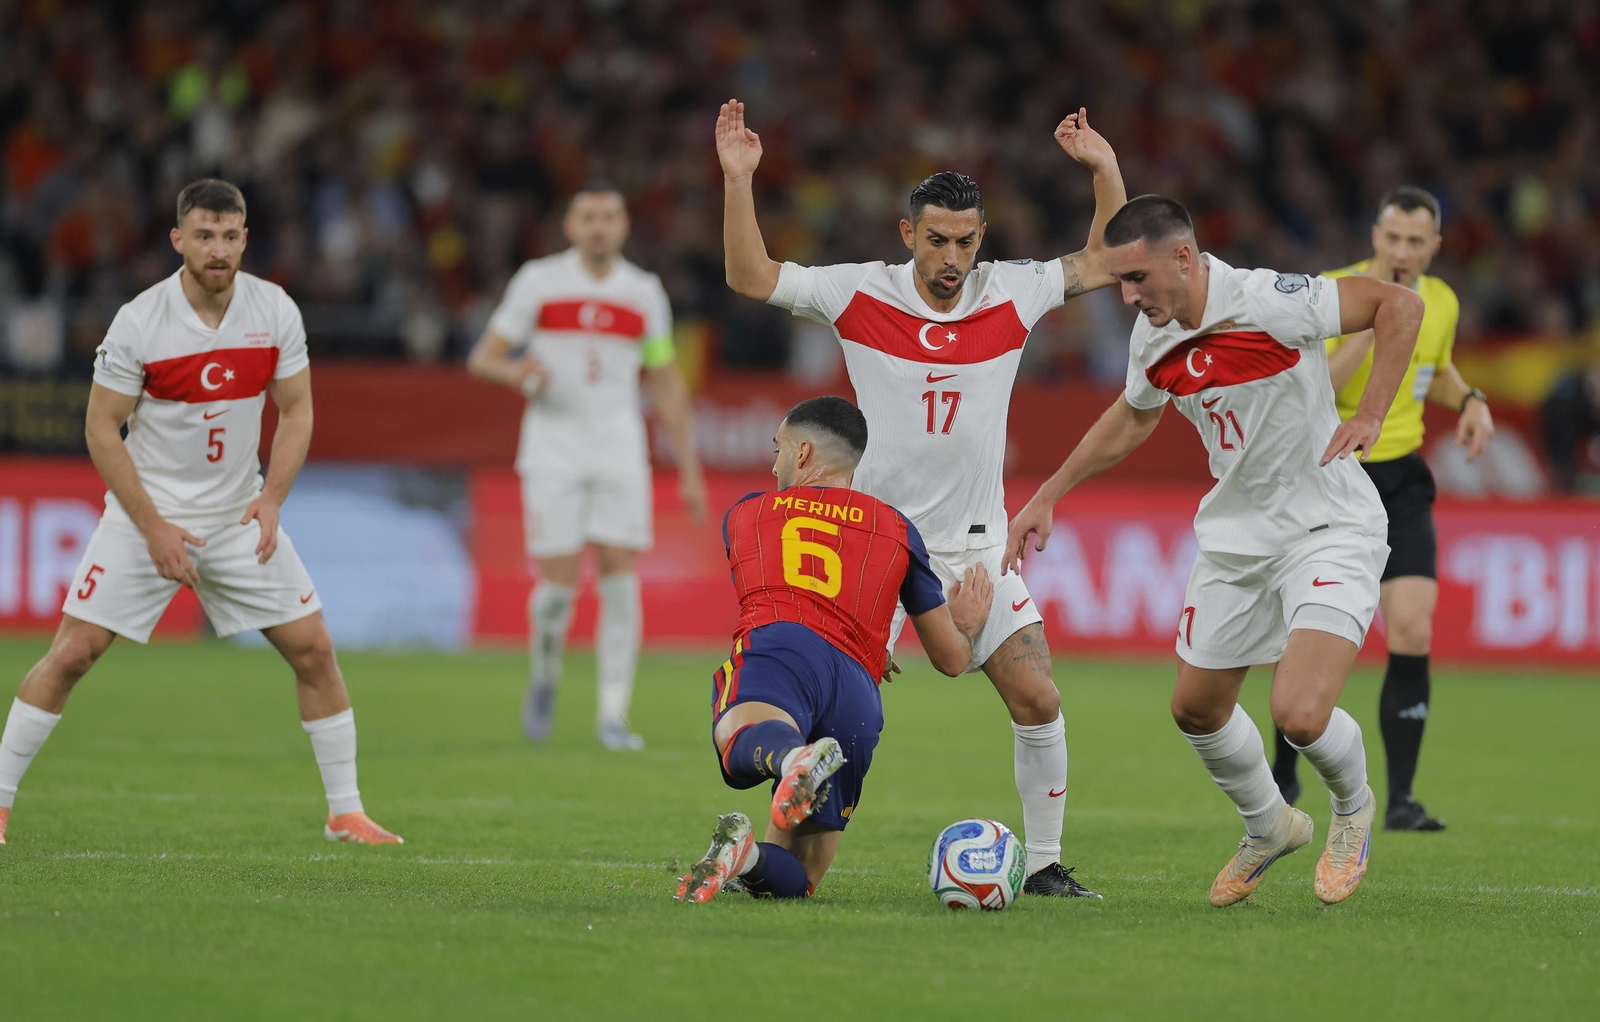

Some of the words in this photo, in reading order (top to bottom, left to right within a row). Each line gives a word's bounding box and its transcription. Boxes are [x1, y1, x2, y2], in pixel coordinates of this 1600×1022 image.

[921, 390, 962, 435] 17
[1209, 410, 1245, 451] 21
[207, 427, 226, 463] 5
[772, 496, 864, 523] MERINO
[781, 516, 842, 599] 6
[77, 564, 105, 601] 5
